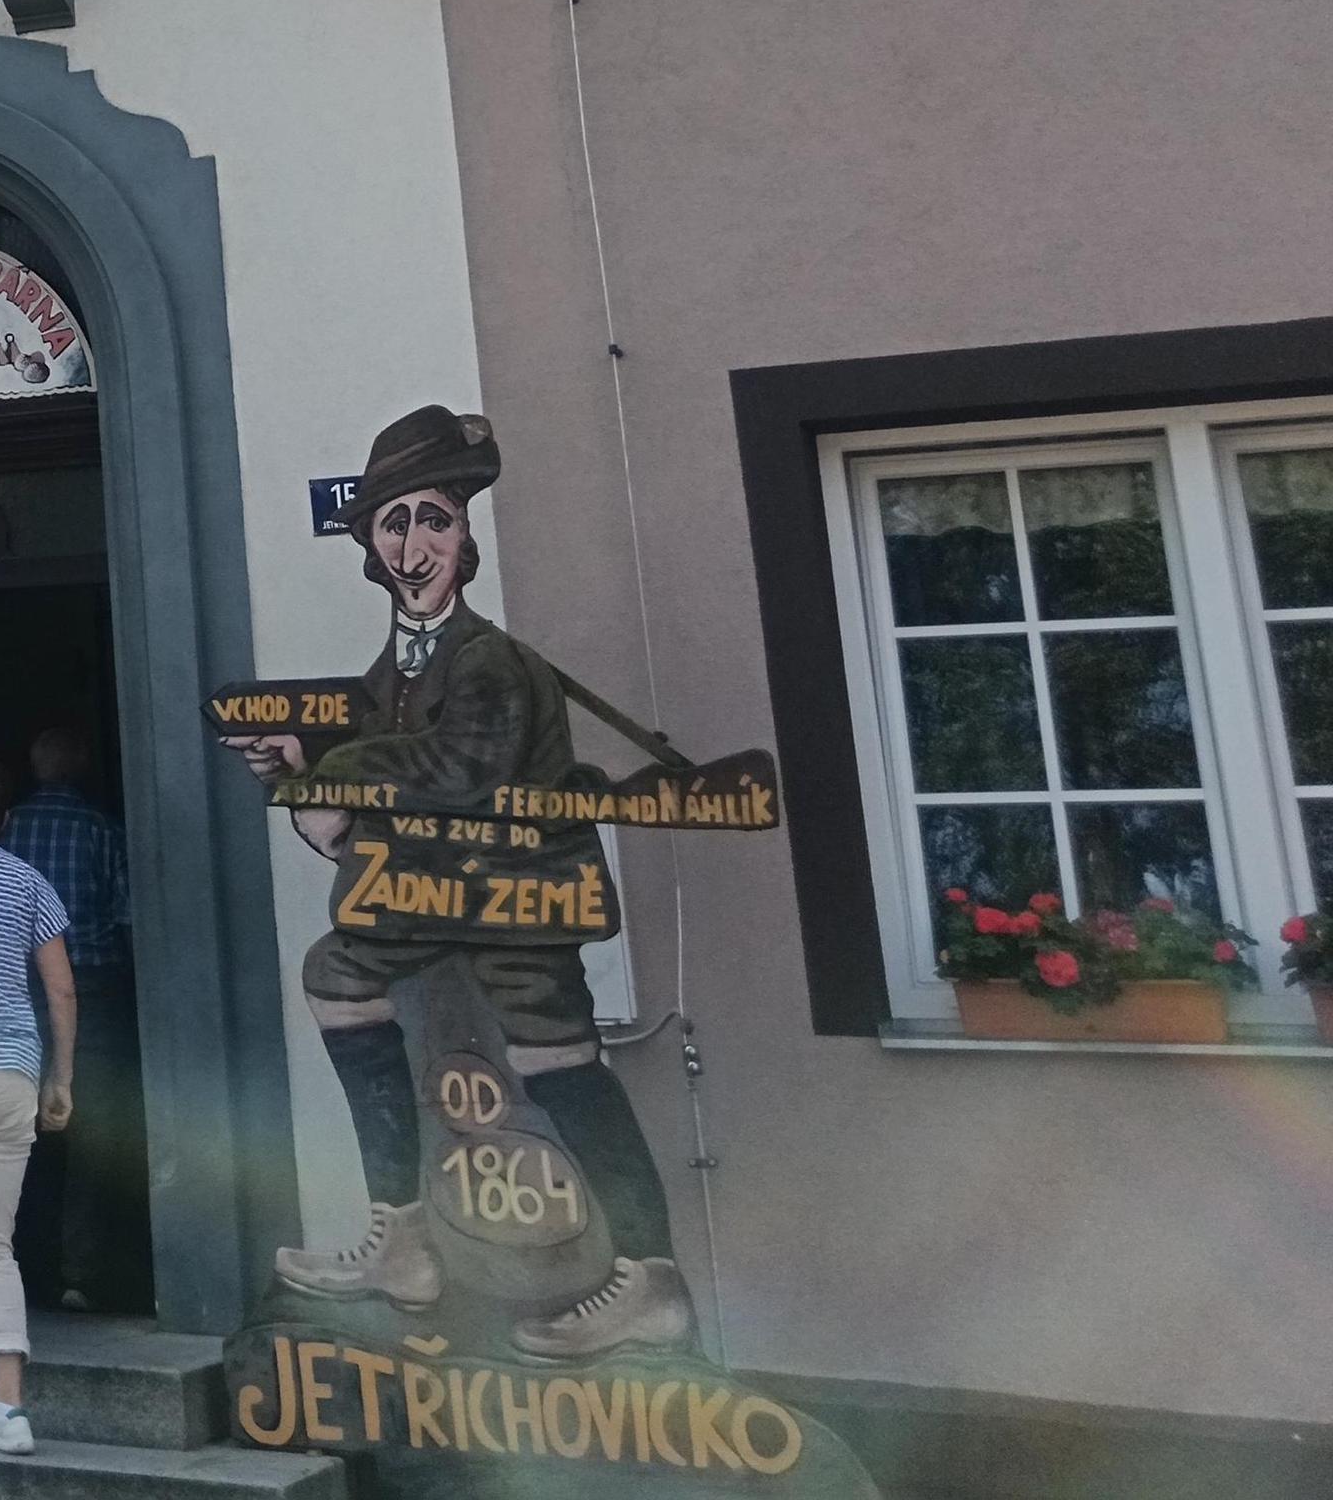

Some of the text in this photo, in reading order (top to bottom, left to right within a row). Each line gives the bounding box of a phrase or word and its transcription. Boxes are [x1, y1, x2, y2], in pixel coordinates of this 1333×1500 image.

[213, 694, 350, 725] VCHOD ZDE
[272, 773, 774, 826] ADJUNKT FERDINAND NÁHLÍK
[447, 819, 496, 844] ZVE
[509, 825, 541, 849] DO
[337, 841, 608, 927] ZADNÍ ZEMĚ
[440, 1071, 503, 1125] OD
[441, 1144, 579, 1225] 1864
[237, 1334, 804, 1475] JETŘICHOVICKO
